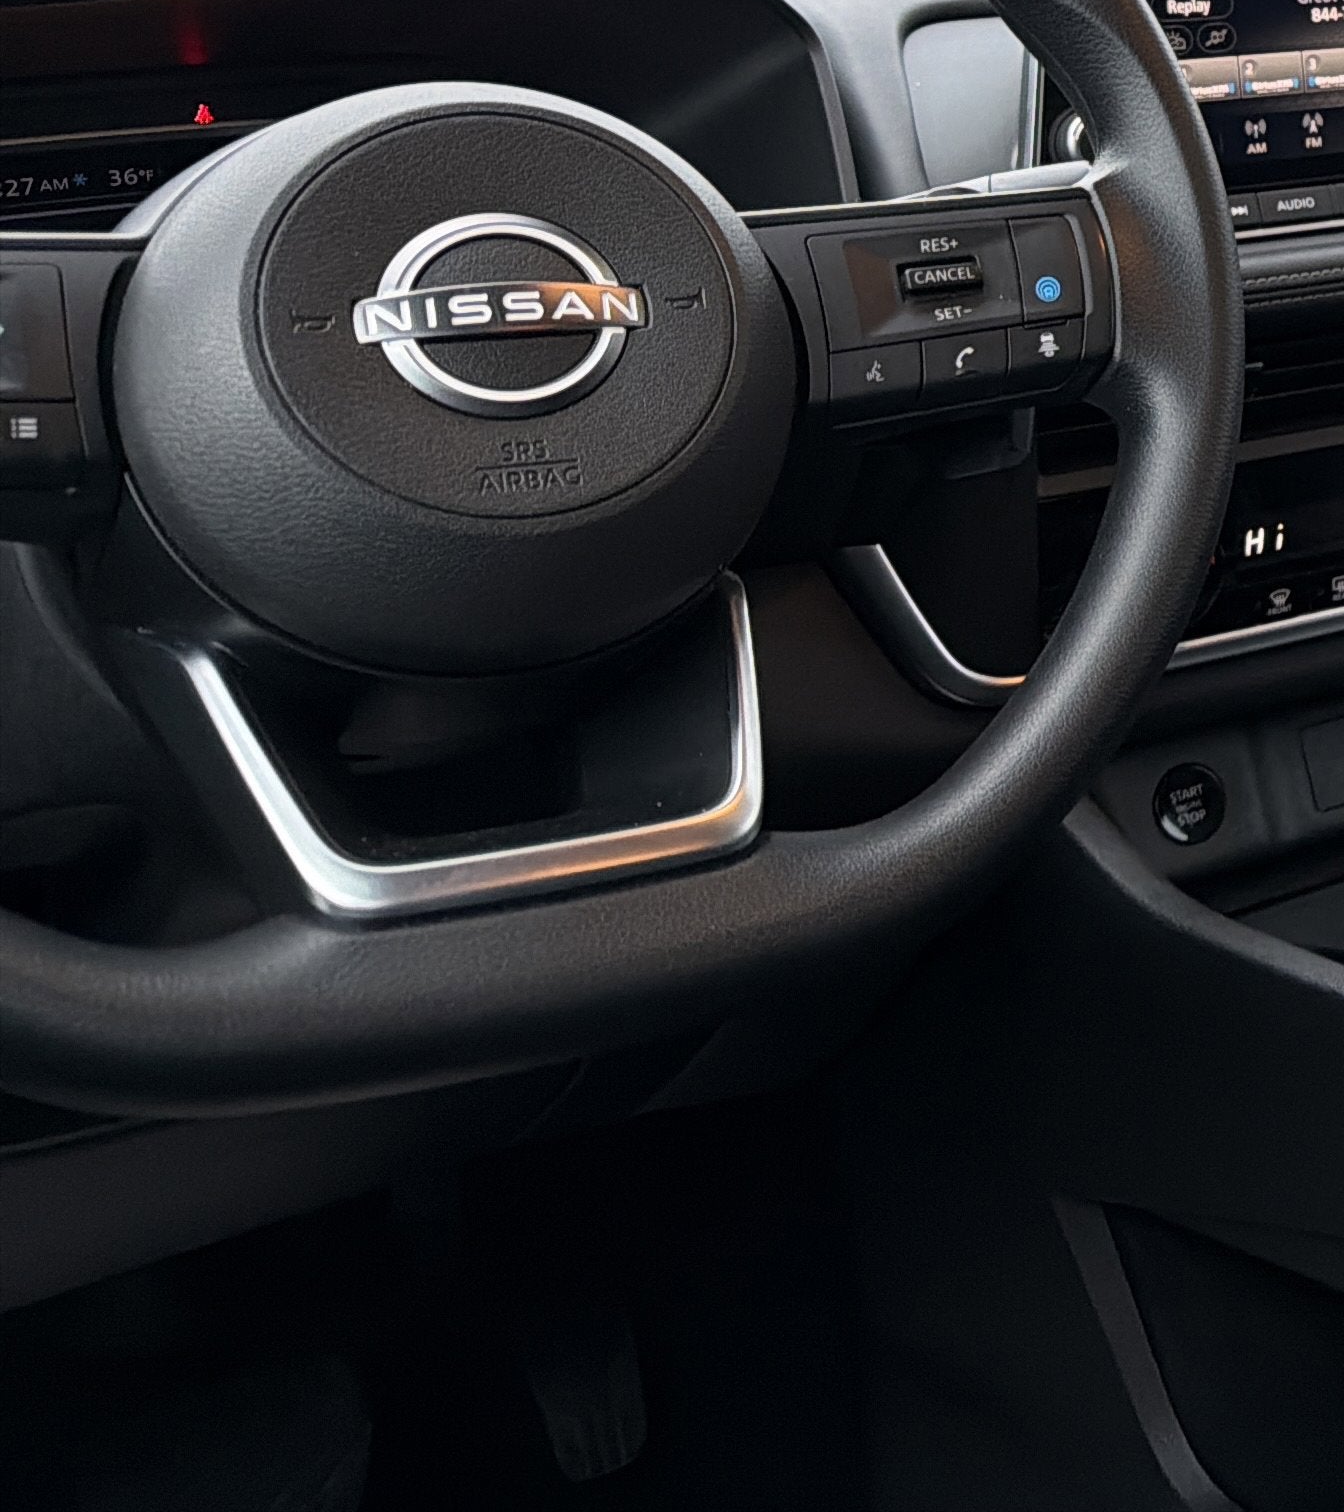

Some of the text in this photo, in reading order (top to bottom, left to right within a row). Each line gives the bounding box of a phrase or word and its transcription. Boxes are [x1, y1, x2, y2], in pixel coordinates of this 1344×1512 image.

[1245, 62, 1254, 76] 2
[1246, 142, 1268, 155] AM
[1305, 136, 1323, 149] FM
[40, 177, 69, 192] AM
[1277, 197, 1315, 212] AUDIO
[920, 239, 958, 253] RES+
[914, 267, 976, 284] CANCEL
[365, 291, 640, 336] NISSAN
[500, 441, 549, 461] SRS
[480, 466, 585, 495] AIRBAG
[1244, 523, 1284, 557] Hi
